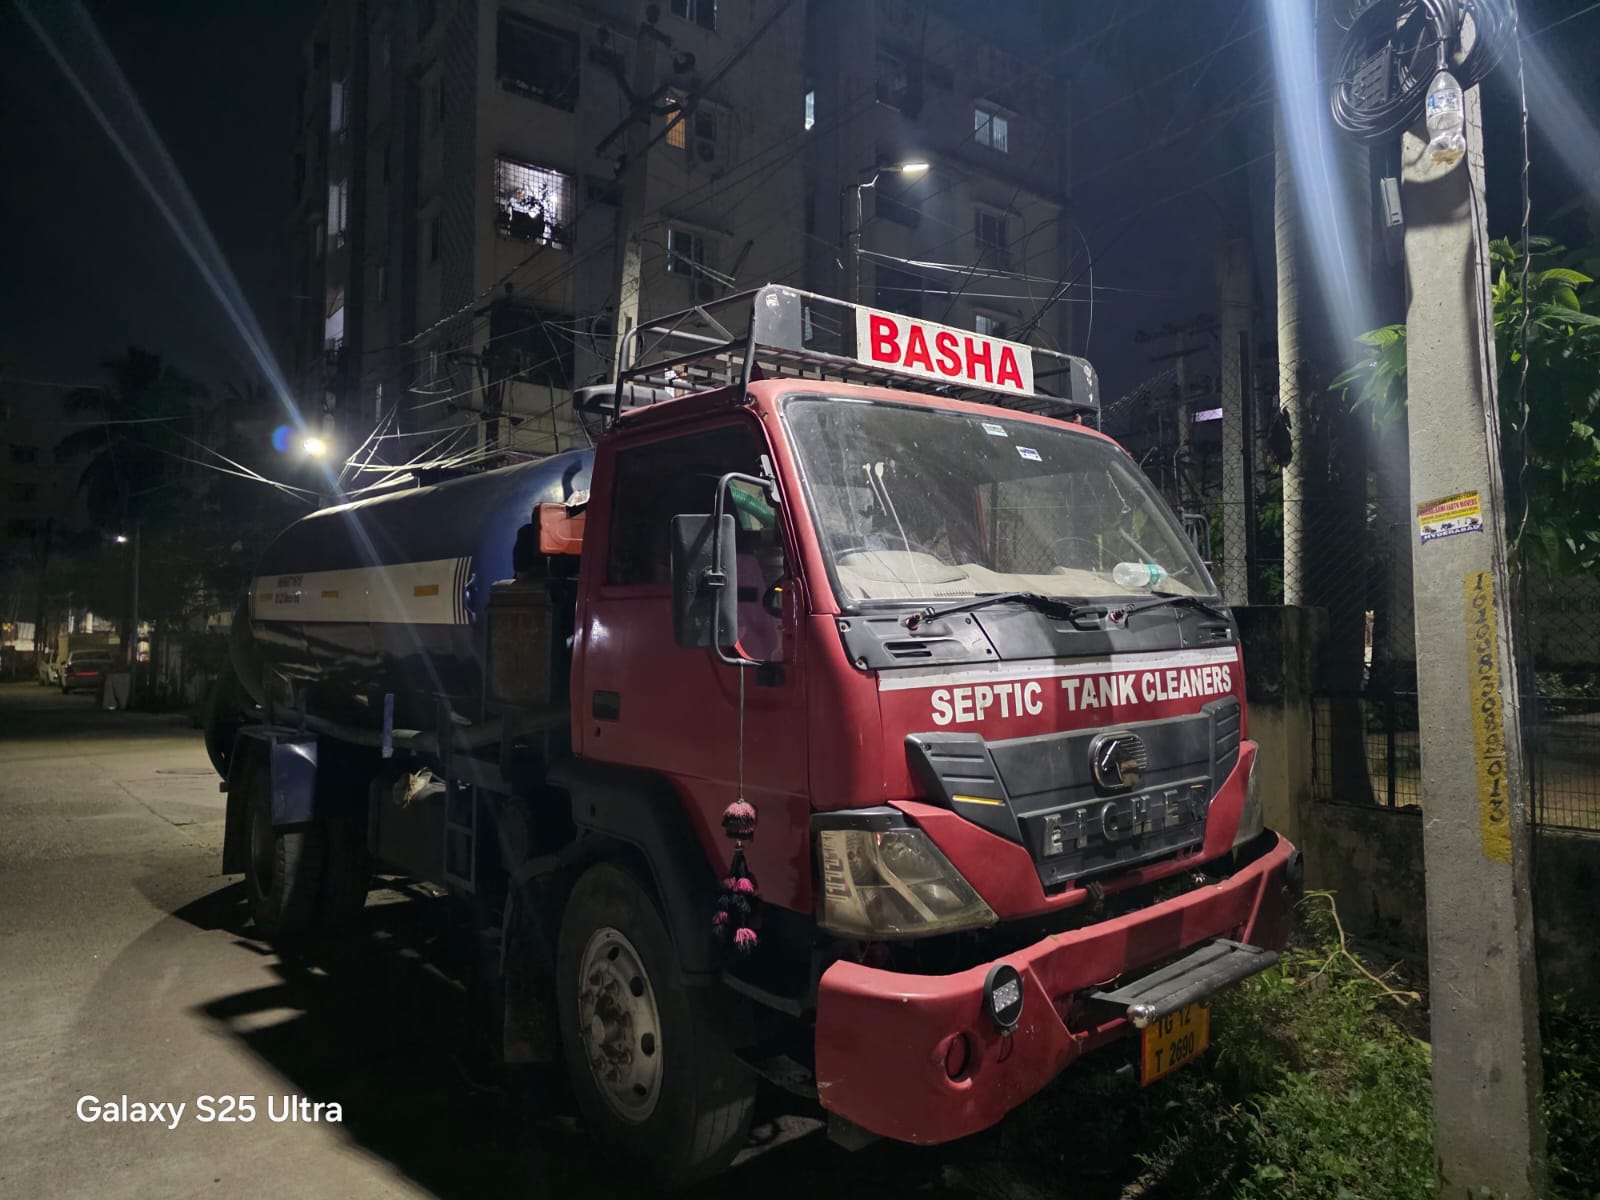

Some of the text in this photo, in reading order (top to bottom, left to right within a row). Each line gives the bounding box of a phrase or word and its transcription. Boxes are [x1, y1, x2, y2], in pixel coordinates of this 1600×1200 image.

[869, 313, 1024, 390] BASHA
[1424, 525, 1480, 539] HYDERABAD
[930, 664, 1232, 726] SEPTIC TANK CLEANERS
[1155, 1031, 1195, 1073] T 2690
